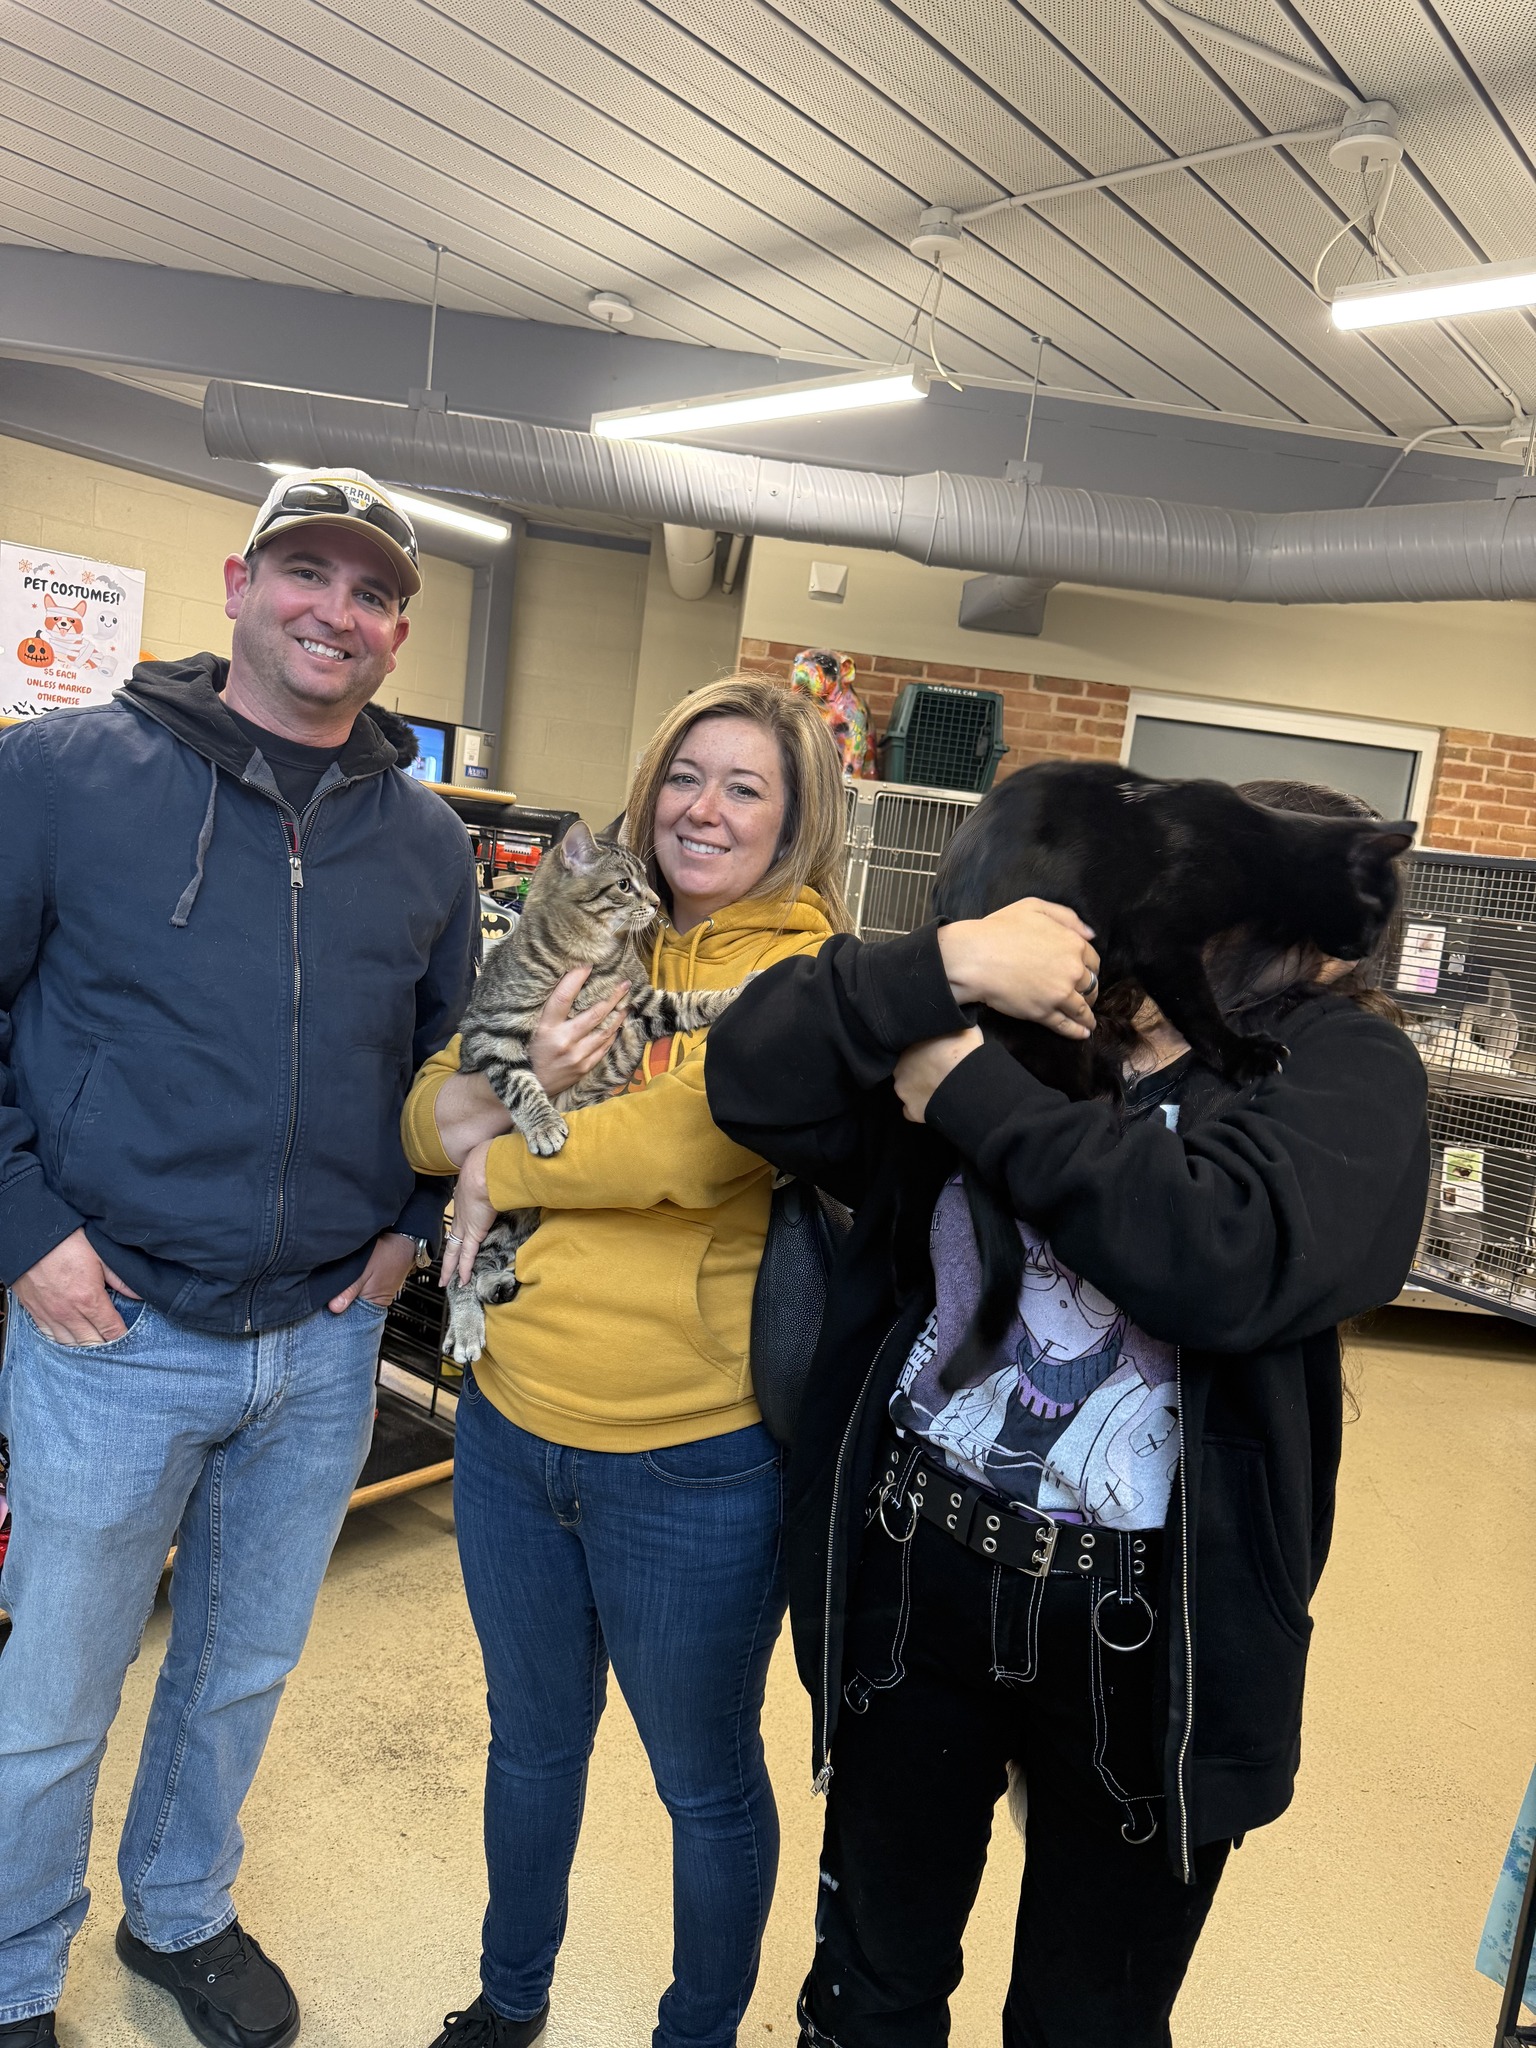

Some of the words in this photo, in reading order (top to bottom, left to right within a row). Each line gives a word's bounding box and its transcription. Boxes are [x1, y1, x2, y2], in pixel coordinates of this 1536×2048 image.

[24, 576, 48, 592] PET
[51, 581, 120, 606] COSTUMES!
[43, 668, 54, 677] $5
[56, 669, 77, 680] EACH
[26, 678, 56, 690] UNLESS
[58, 682, 92, 695] MARKED
[37, 693, 81, 706] OTHERWISE
